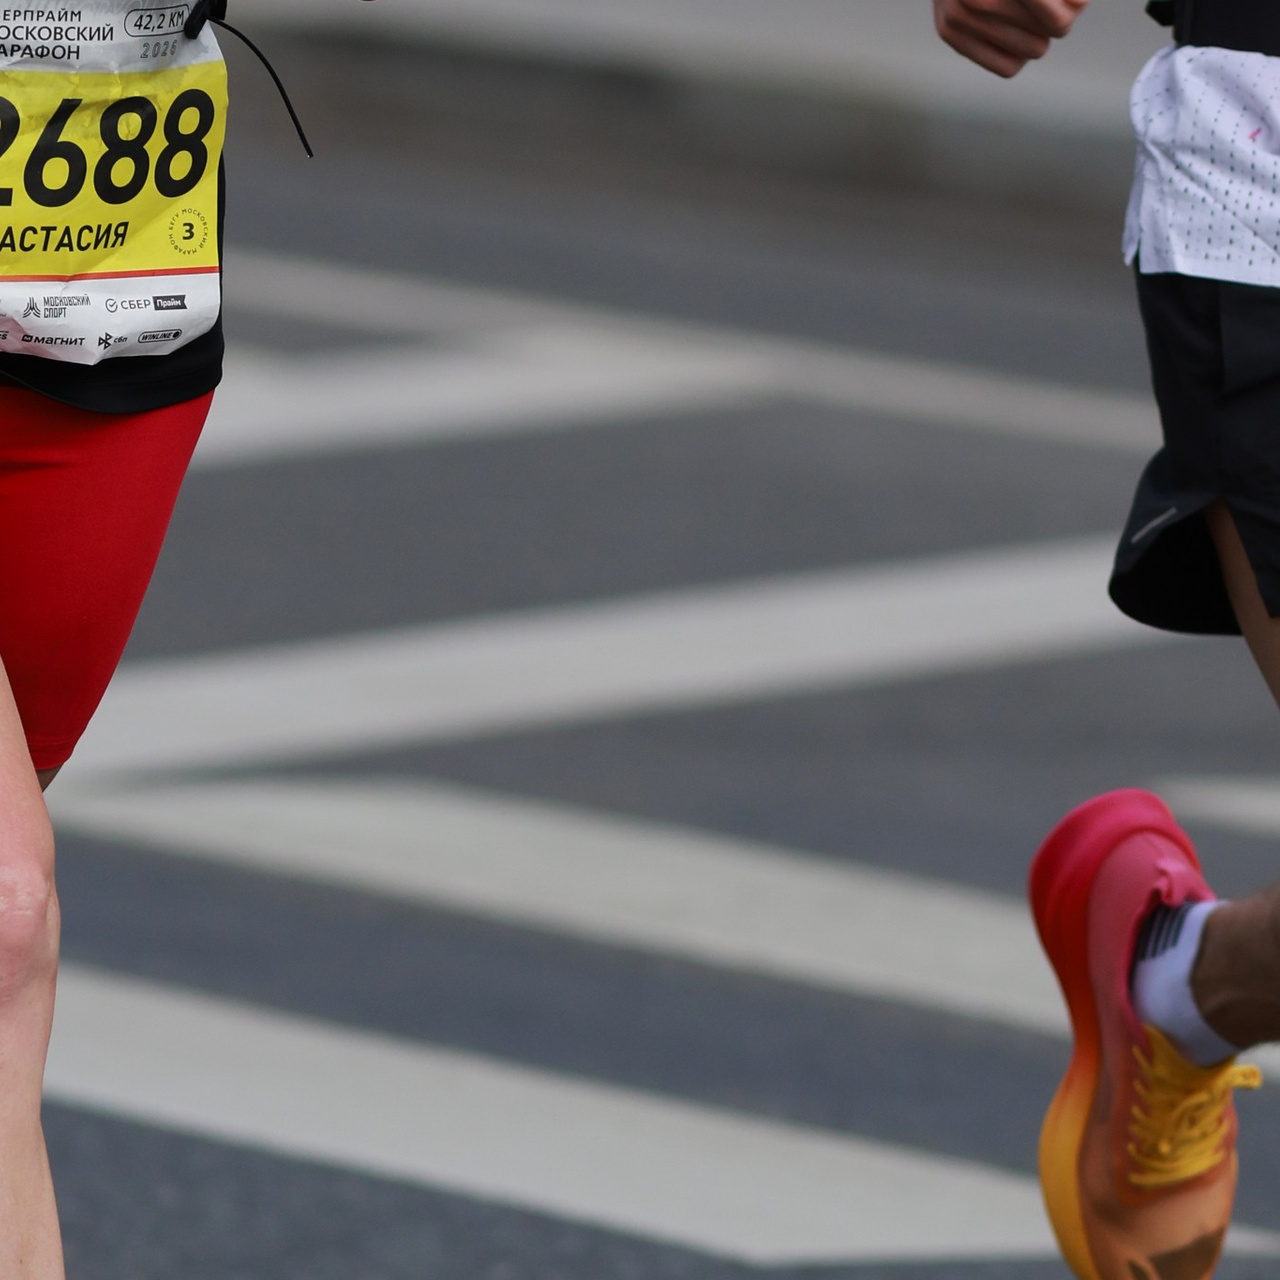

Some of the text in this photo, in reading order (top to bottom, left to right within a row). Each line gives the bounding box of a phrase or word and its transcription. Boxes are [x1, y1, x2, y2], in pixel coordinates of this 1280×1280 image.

[133, 10, 185, 32] 42,2 КМ
[182, 222, 195, 240] 3
[43, 293, 91, 306] МОСКОВСКИЙ
[121, 299, 182, 310] СБЕР Прайм
[43, 307, 67, 318] СПОРТ
[33, 336, 86, 346] магнит
[141, 332, 172, 341] WINLINE
